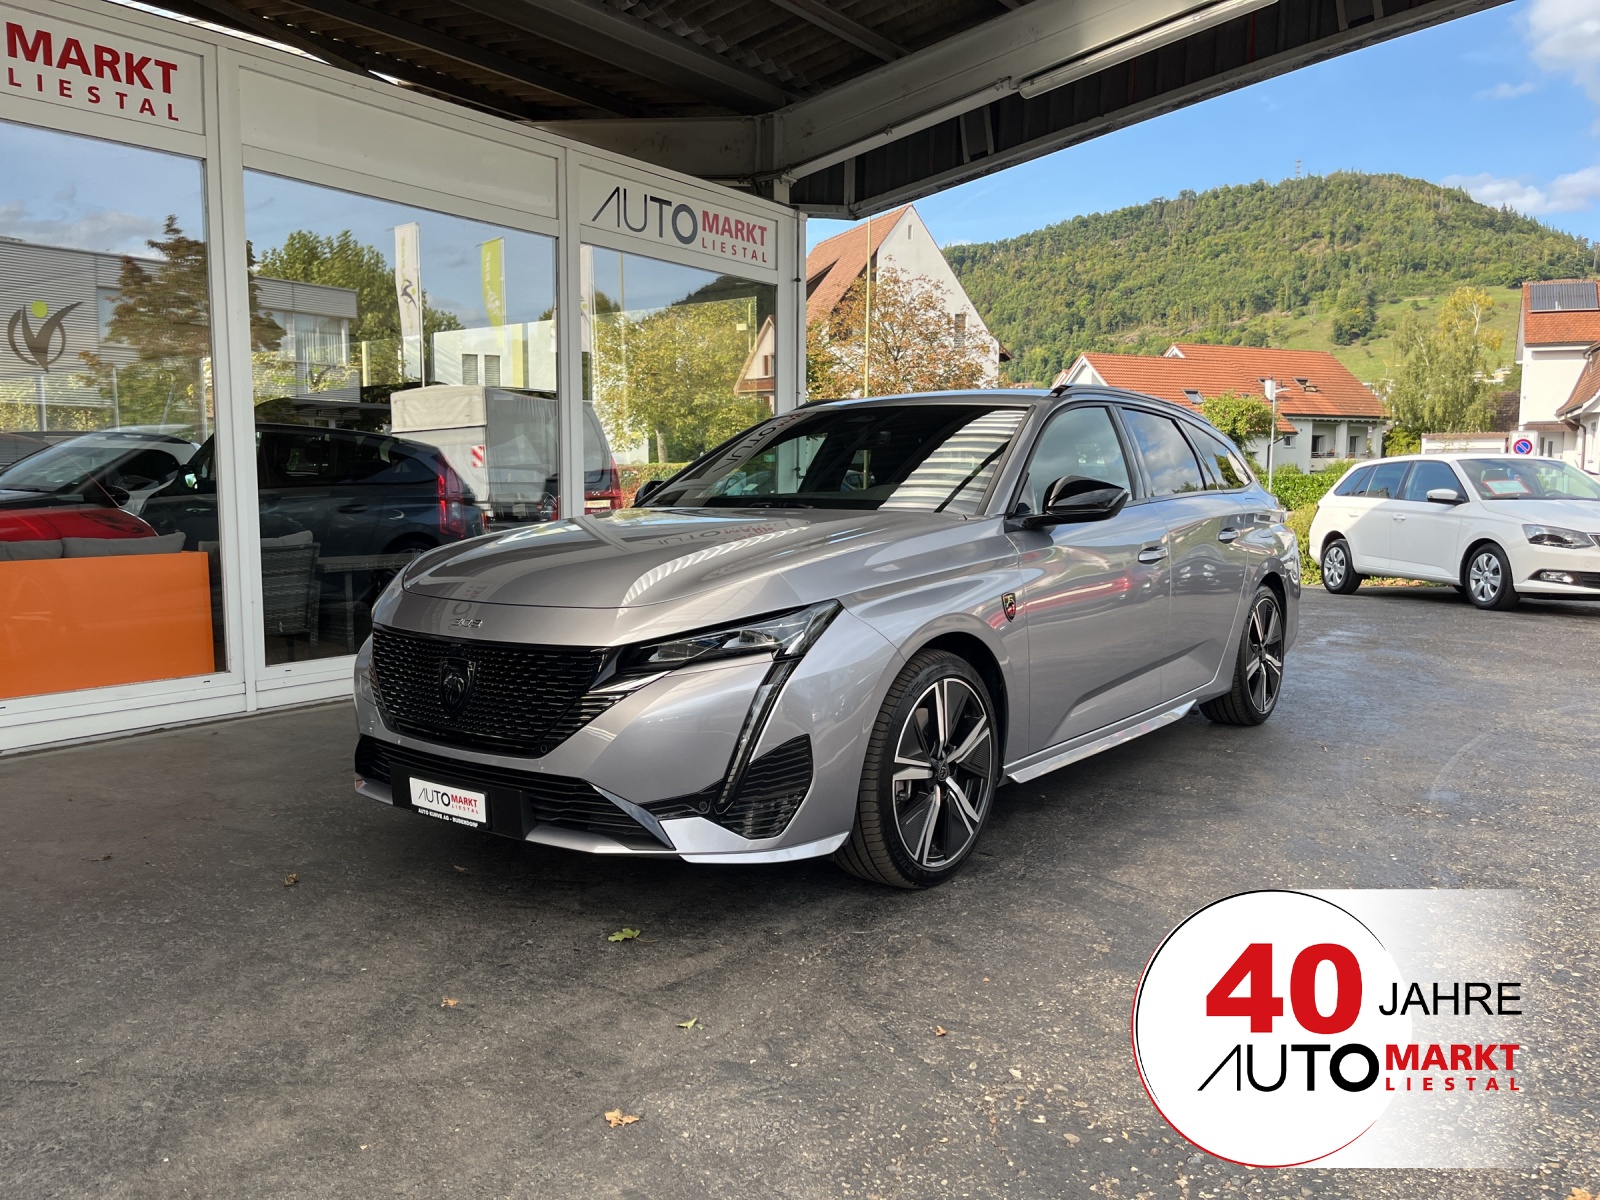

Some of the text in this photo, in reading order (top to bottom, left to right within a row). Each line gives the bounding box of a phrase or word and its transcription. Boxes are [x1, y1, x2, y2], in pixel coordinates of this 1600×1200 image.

[6, 22, 178, 95] MARKT
[7, 67, 179, 122] LIESTAL
[591, 186, 768, 247] AUTO MARKT
[702, 237, 767, 263] LIESTAL
[418, 788, 478, 808] AUTO MARKT
[452, 803, 479, 815] LIESTAL
